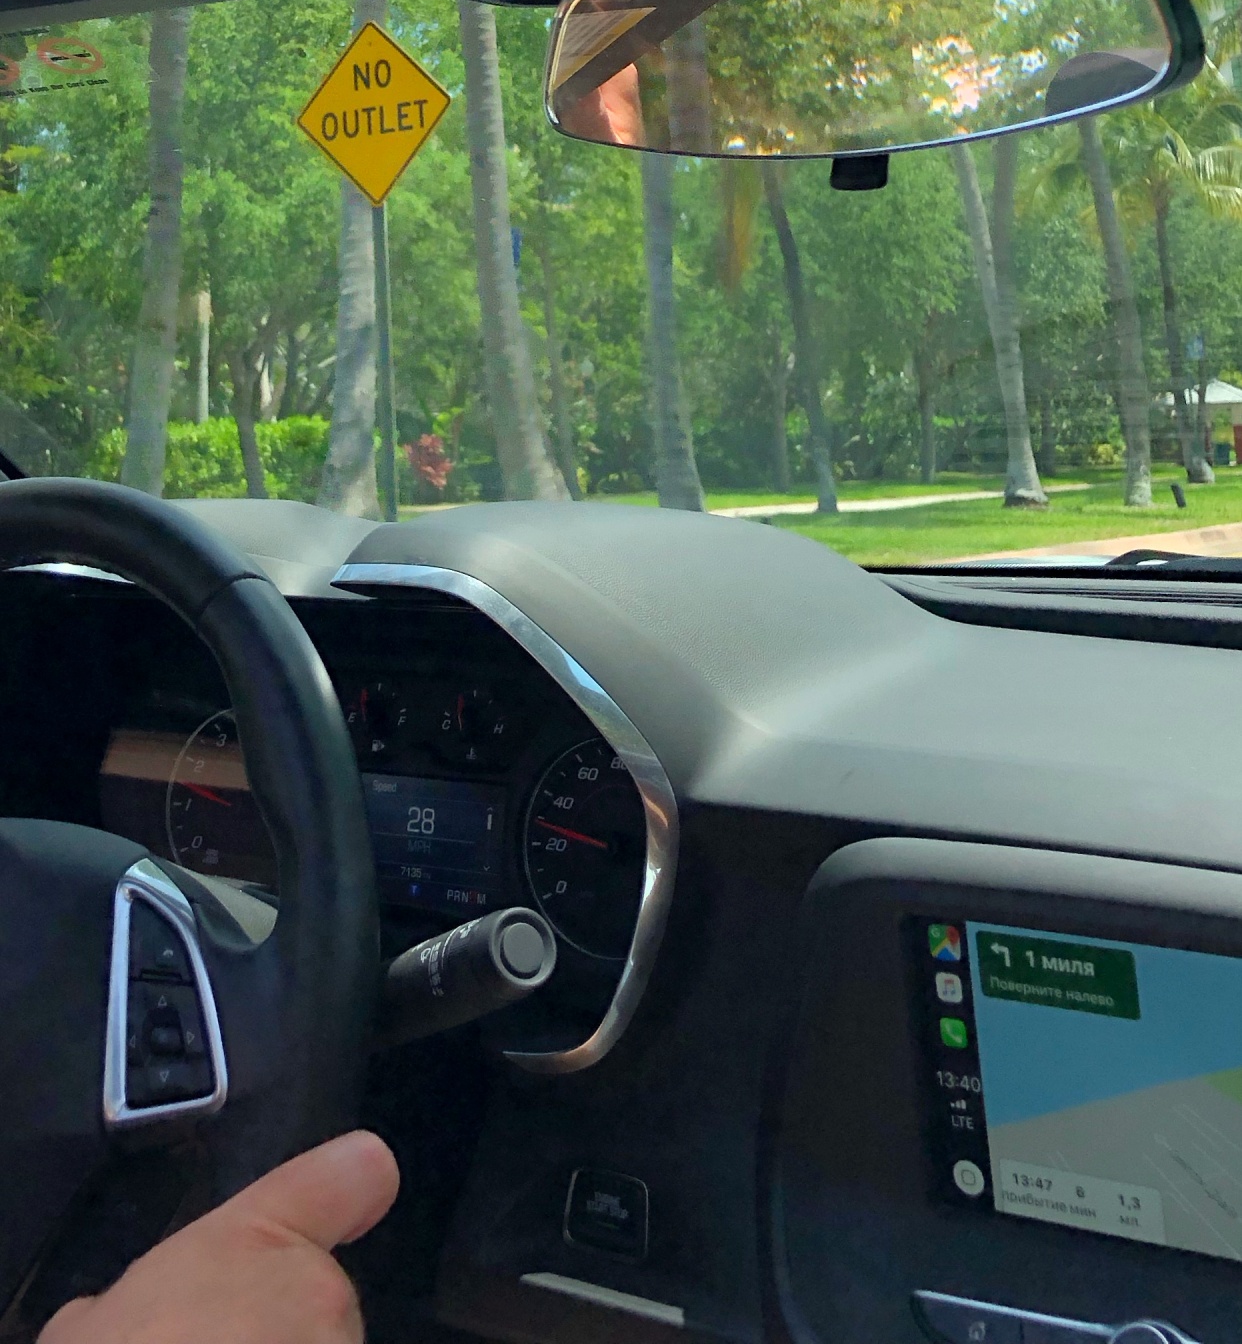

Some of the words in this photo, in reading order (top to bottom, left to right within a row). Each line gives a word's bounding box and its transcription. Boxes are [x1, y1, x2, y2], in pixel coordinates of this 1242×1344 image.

[353, 59, 391, 91] NO
[322, 99, 428, 141] OUTLET
[348, 712, 356, 723] E
[397, 715, 407, 726] F
[441, 719, 451, 730] C
[493, 724, 504, 734] H
[216, 734, 227, 747] 3
[194, 760, 205, 773] 2
[578, 767, 599, 781] 60
[372, 779, 397, 793] Speed
[185, 798, 192, 811] 1
[553, 796, 574, 810] 40
[407, 806, 435, 834] 28
[191, 836, 203, 849] 0
[545, 838, 567, 852] 20
[556, 881, 567, 893] 0
[1025, 950, 1035, 968] 1
[1042, 955, 1095, 977] миля
[989, 975, 1062, 997] Поверните
[1066, 988, 1115, 1007] налево
[936, 1070, 982, 1093] 13:40
[951, 1115, 975, 1130] LTE
[1012, 1172, 1053, 1191] 13:47
[1118, 1193, 1141, 1211] 1,3
[1001, 1190, 1066, 1213] прибытие
